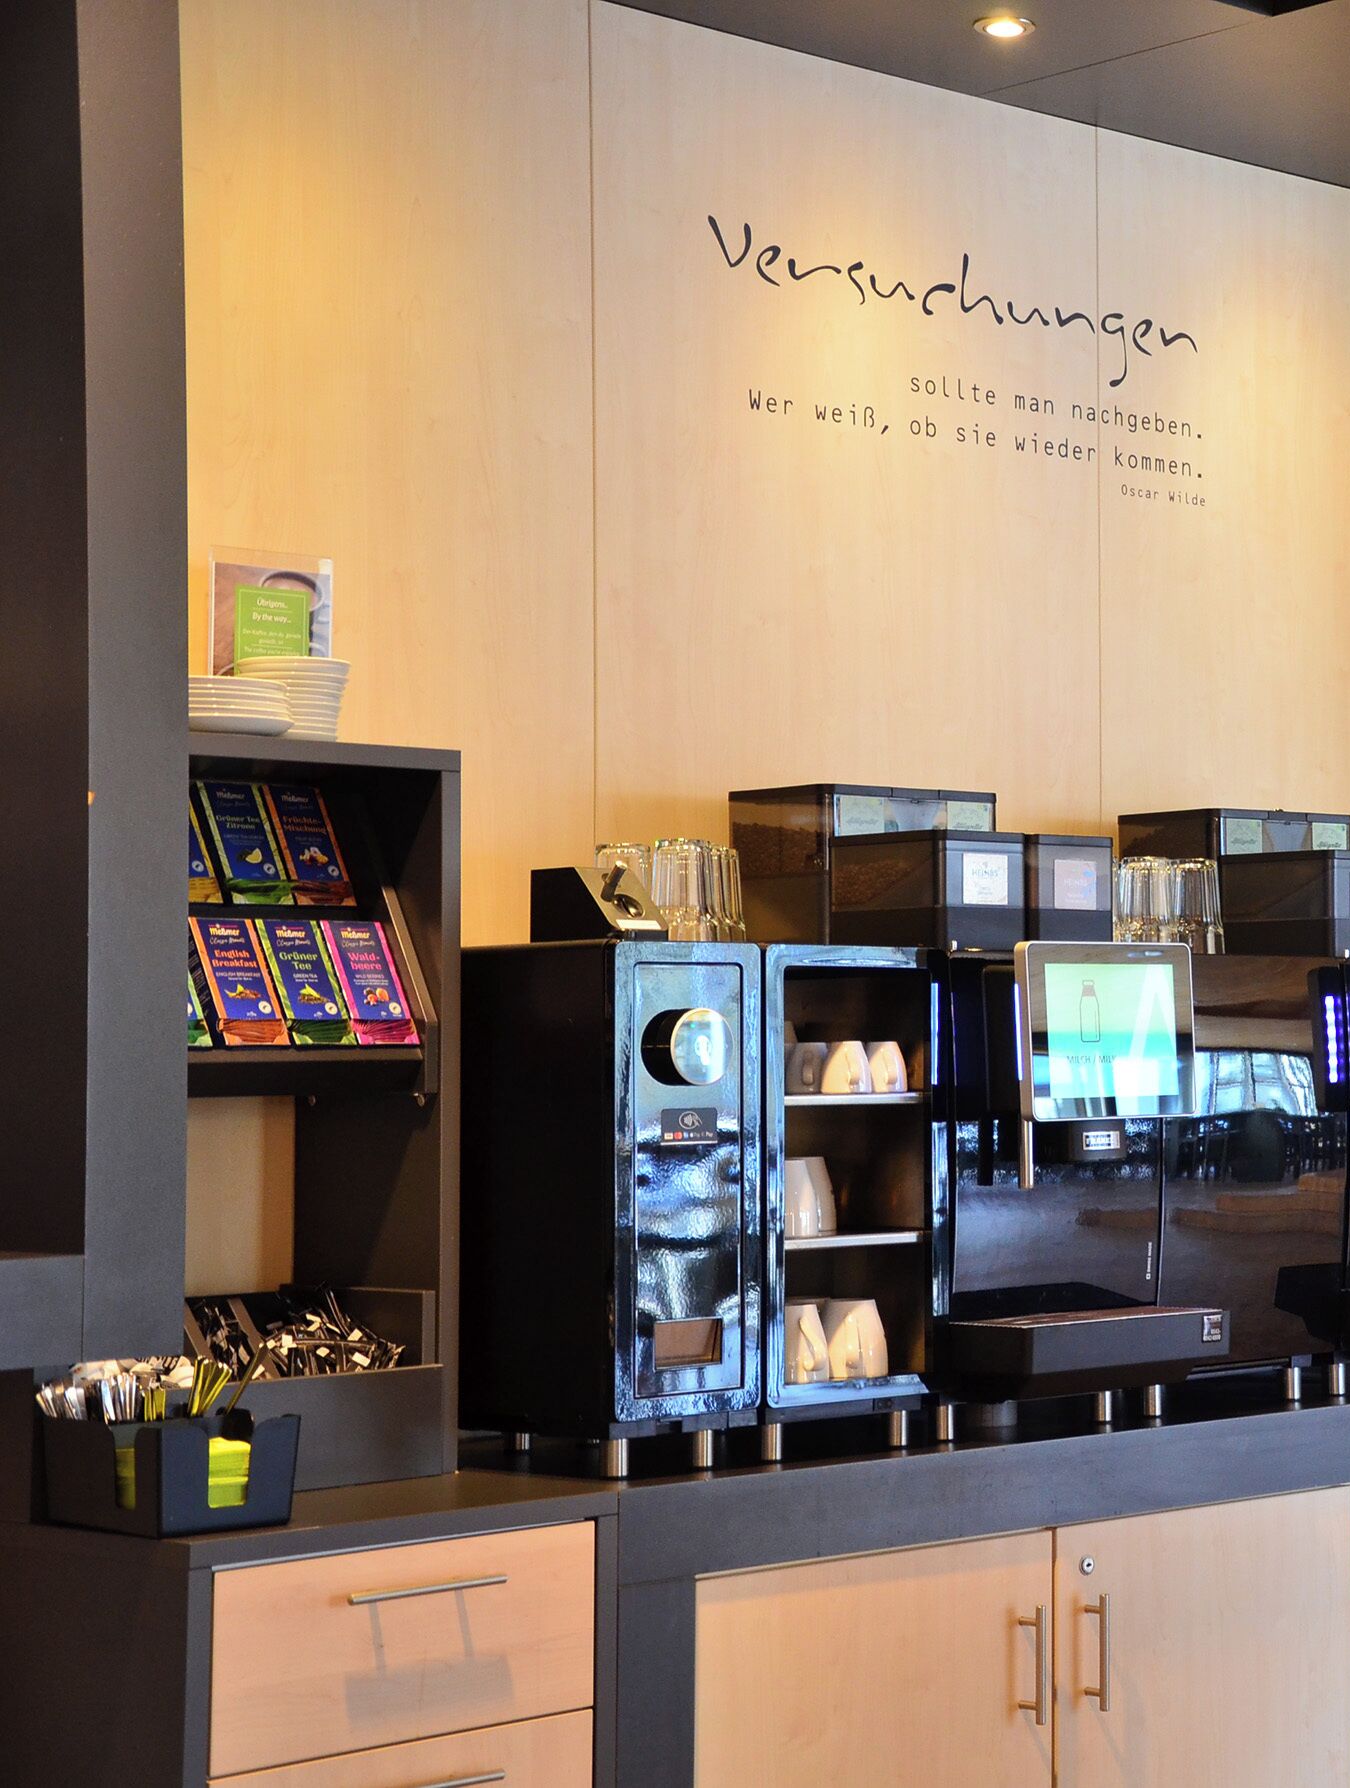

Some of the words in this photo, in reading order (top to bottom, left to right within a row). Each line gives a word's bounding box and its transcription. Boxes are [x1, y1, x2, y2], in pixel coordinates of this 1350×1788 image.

[708, 215, 1199, 387] Versuchungen
[911, 375, 997, 406] sollte
[1014, 394, 1055, 416] man
[1071, 404, 1202, 440] nachgeben.
[748, 388, 794, 416] Wer
[814, 403, 890, 436] weiß,
[909, 415, 938, 438] ob
[956, 422, 997, 448] sie
[1014, 432, 1097, 463] wieder
[1114, 445, 1203, 479] kommen.
[1120, 484, 1160, 501] Oscar
[1168, 490, 1207, 507] Wilde
[262, 612, 273, 622] the
[209, 926, 240, 937] Meßmer
[275, 929, 306, 938] Meßmer
[214, 949, 250, 959] English
[278, 951, 319, 961] Grüner
[347, 952, 381, 961] Wald-
[212, 959, 258, 968] Breakfast
[291, 960, 312, 970] Tee
[350, 961, 382, 970] beere
[1066, 1056, 1091, 1064] MILCH
